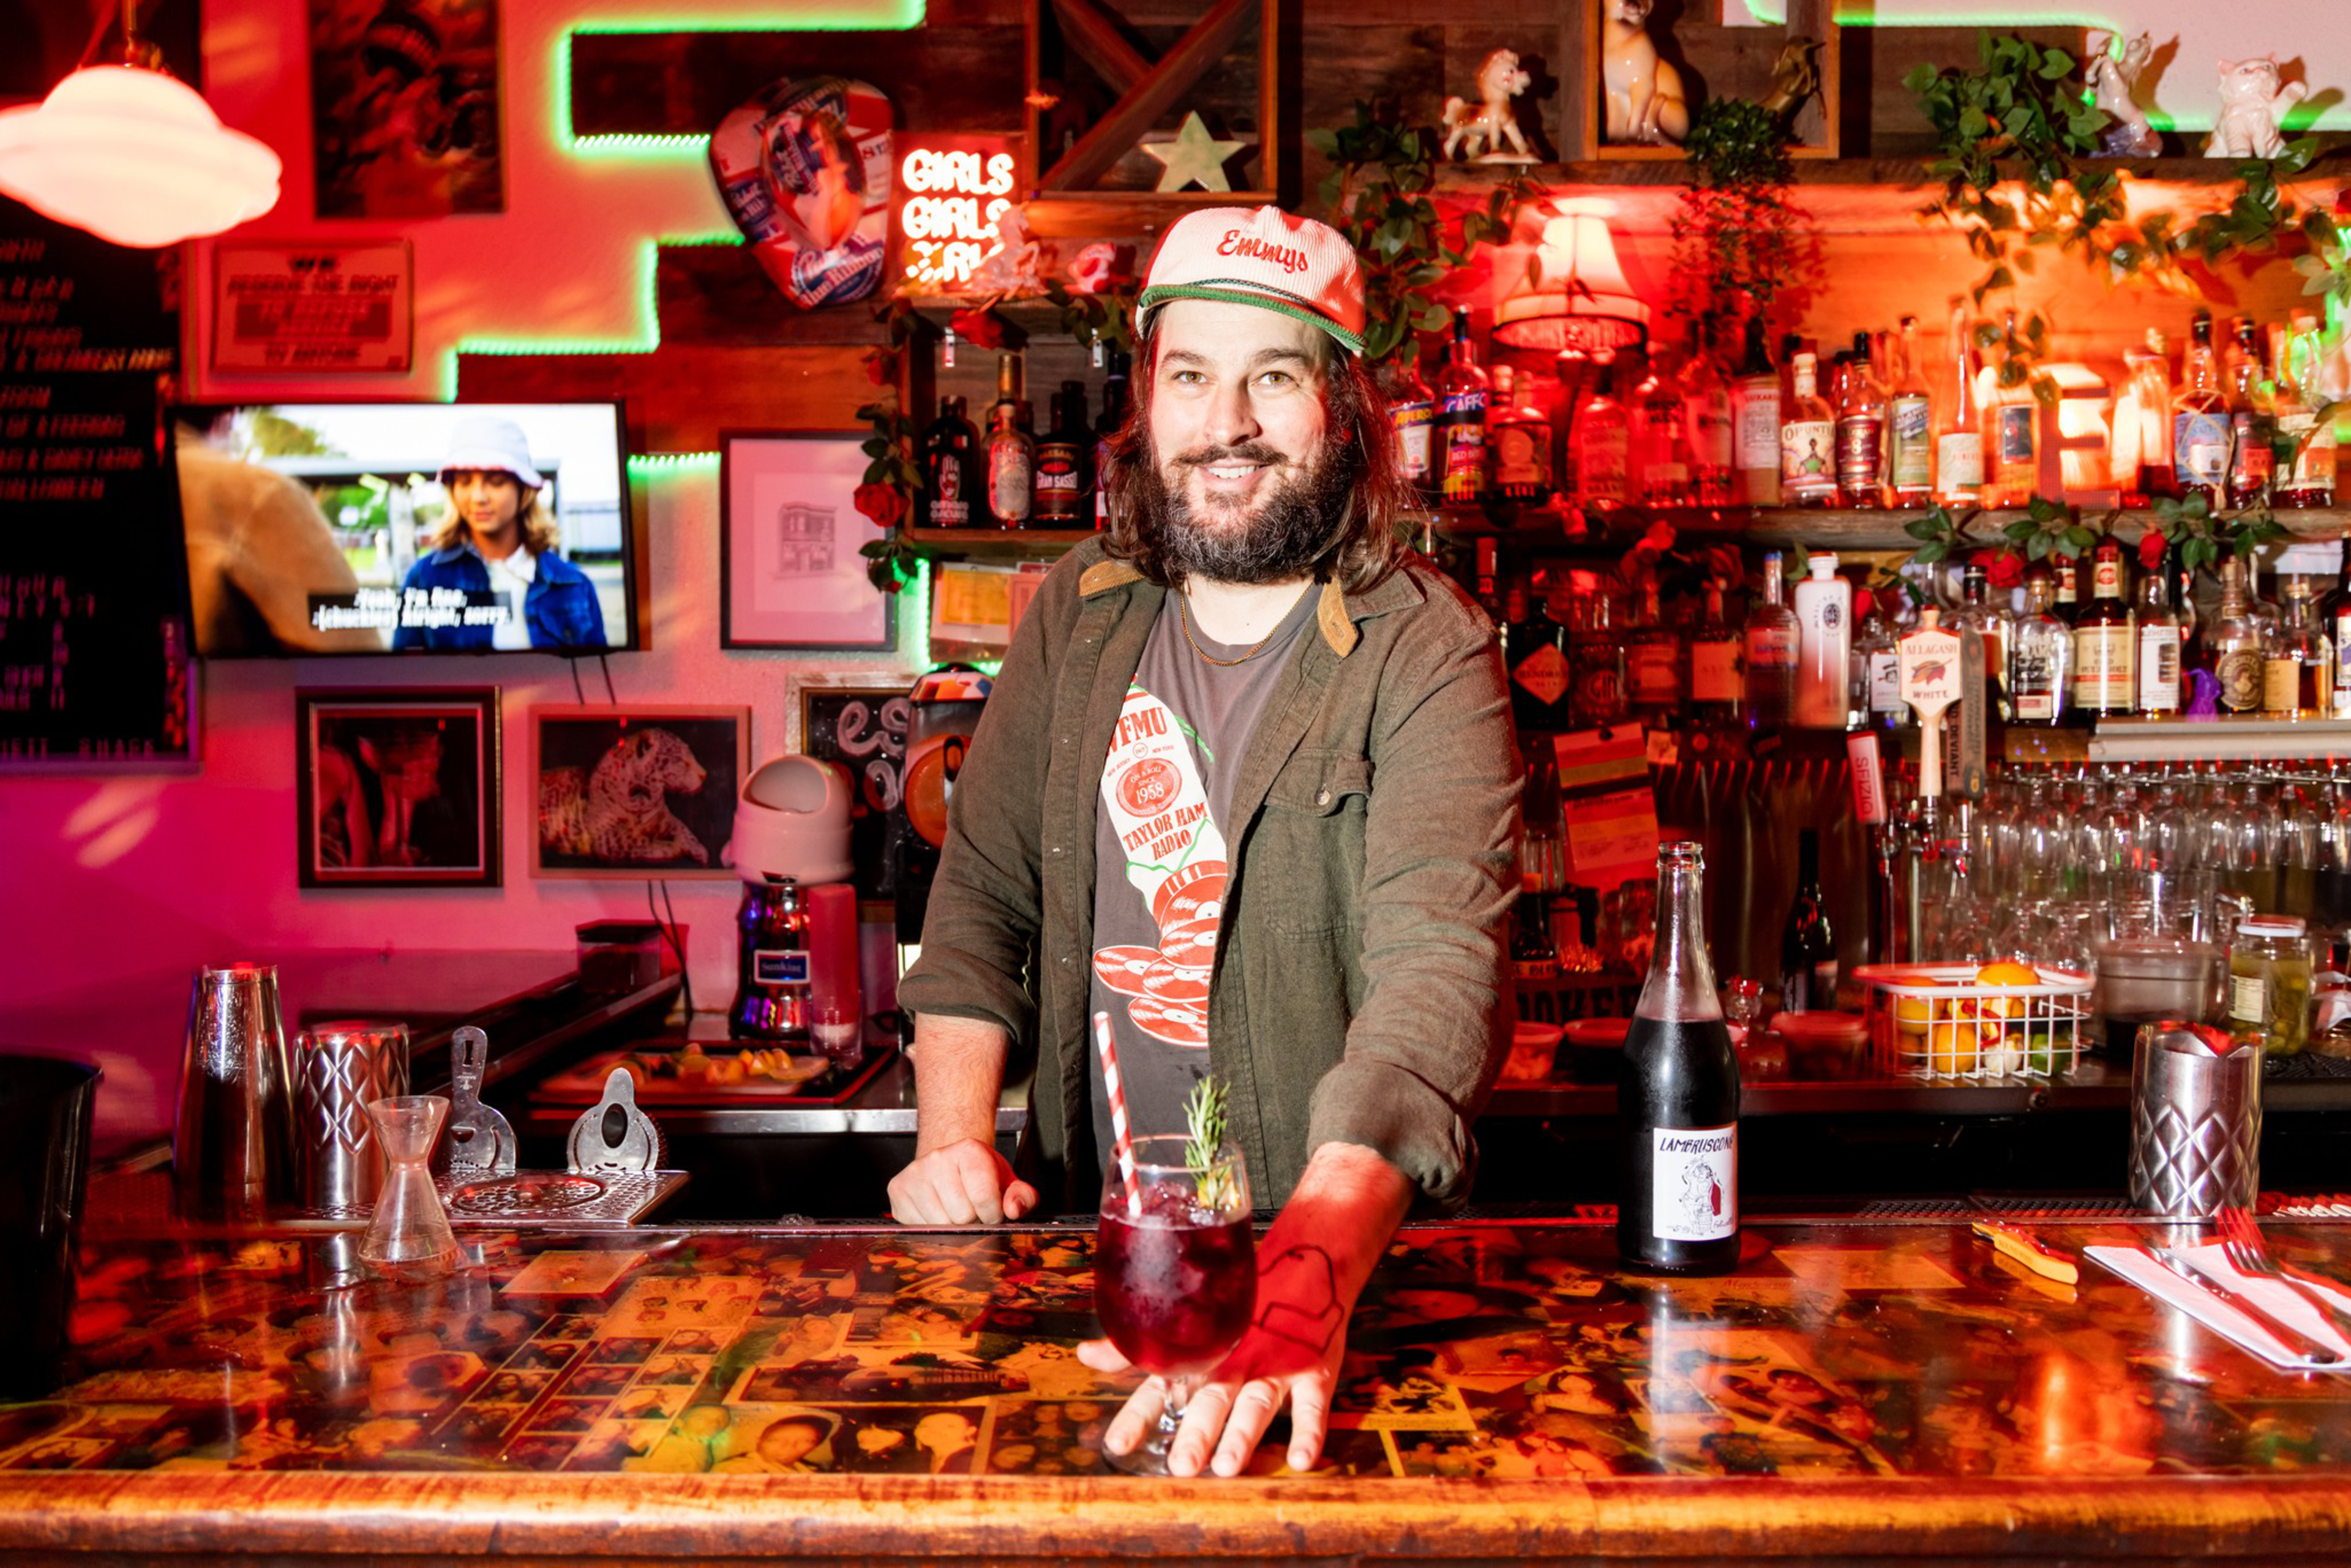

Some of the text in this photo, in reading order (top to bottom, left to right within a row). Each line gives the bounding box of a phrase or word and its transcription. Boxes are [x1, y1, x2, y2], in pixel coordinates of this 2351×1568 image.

[902, 149, 1014, 195] GIRLS
[1217, 230, 1308, 274] Emmys
[1905, 644, 1957, 655] ALLAGASH
[1913, 689, 1949, 699] WHITE
[1949, 726, 1960, 778] DEVIANT
[1130, 772, 1141, 783] ON
[1138, 776, 1156, 787] SINCE
[1136, 781, 1164, 805] 1958
[1122, 801, 1209, 853] TAYLOR HAM
[1150, 828, 1193, 861] RADIO
